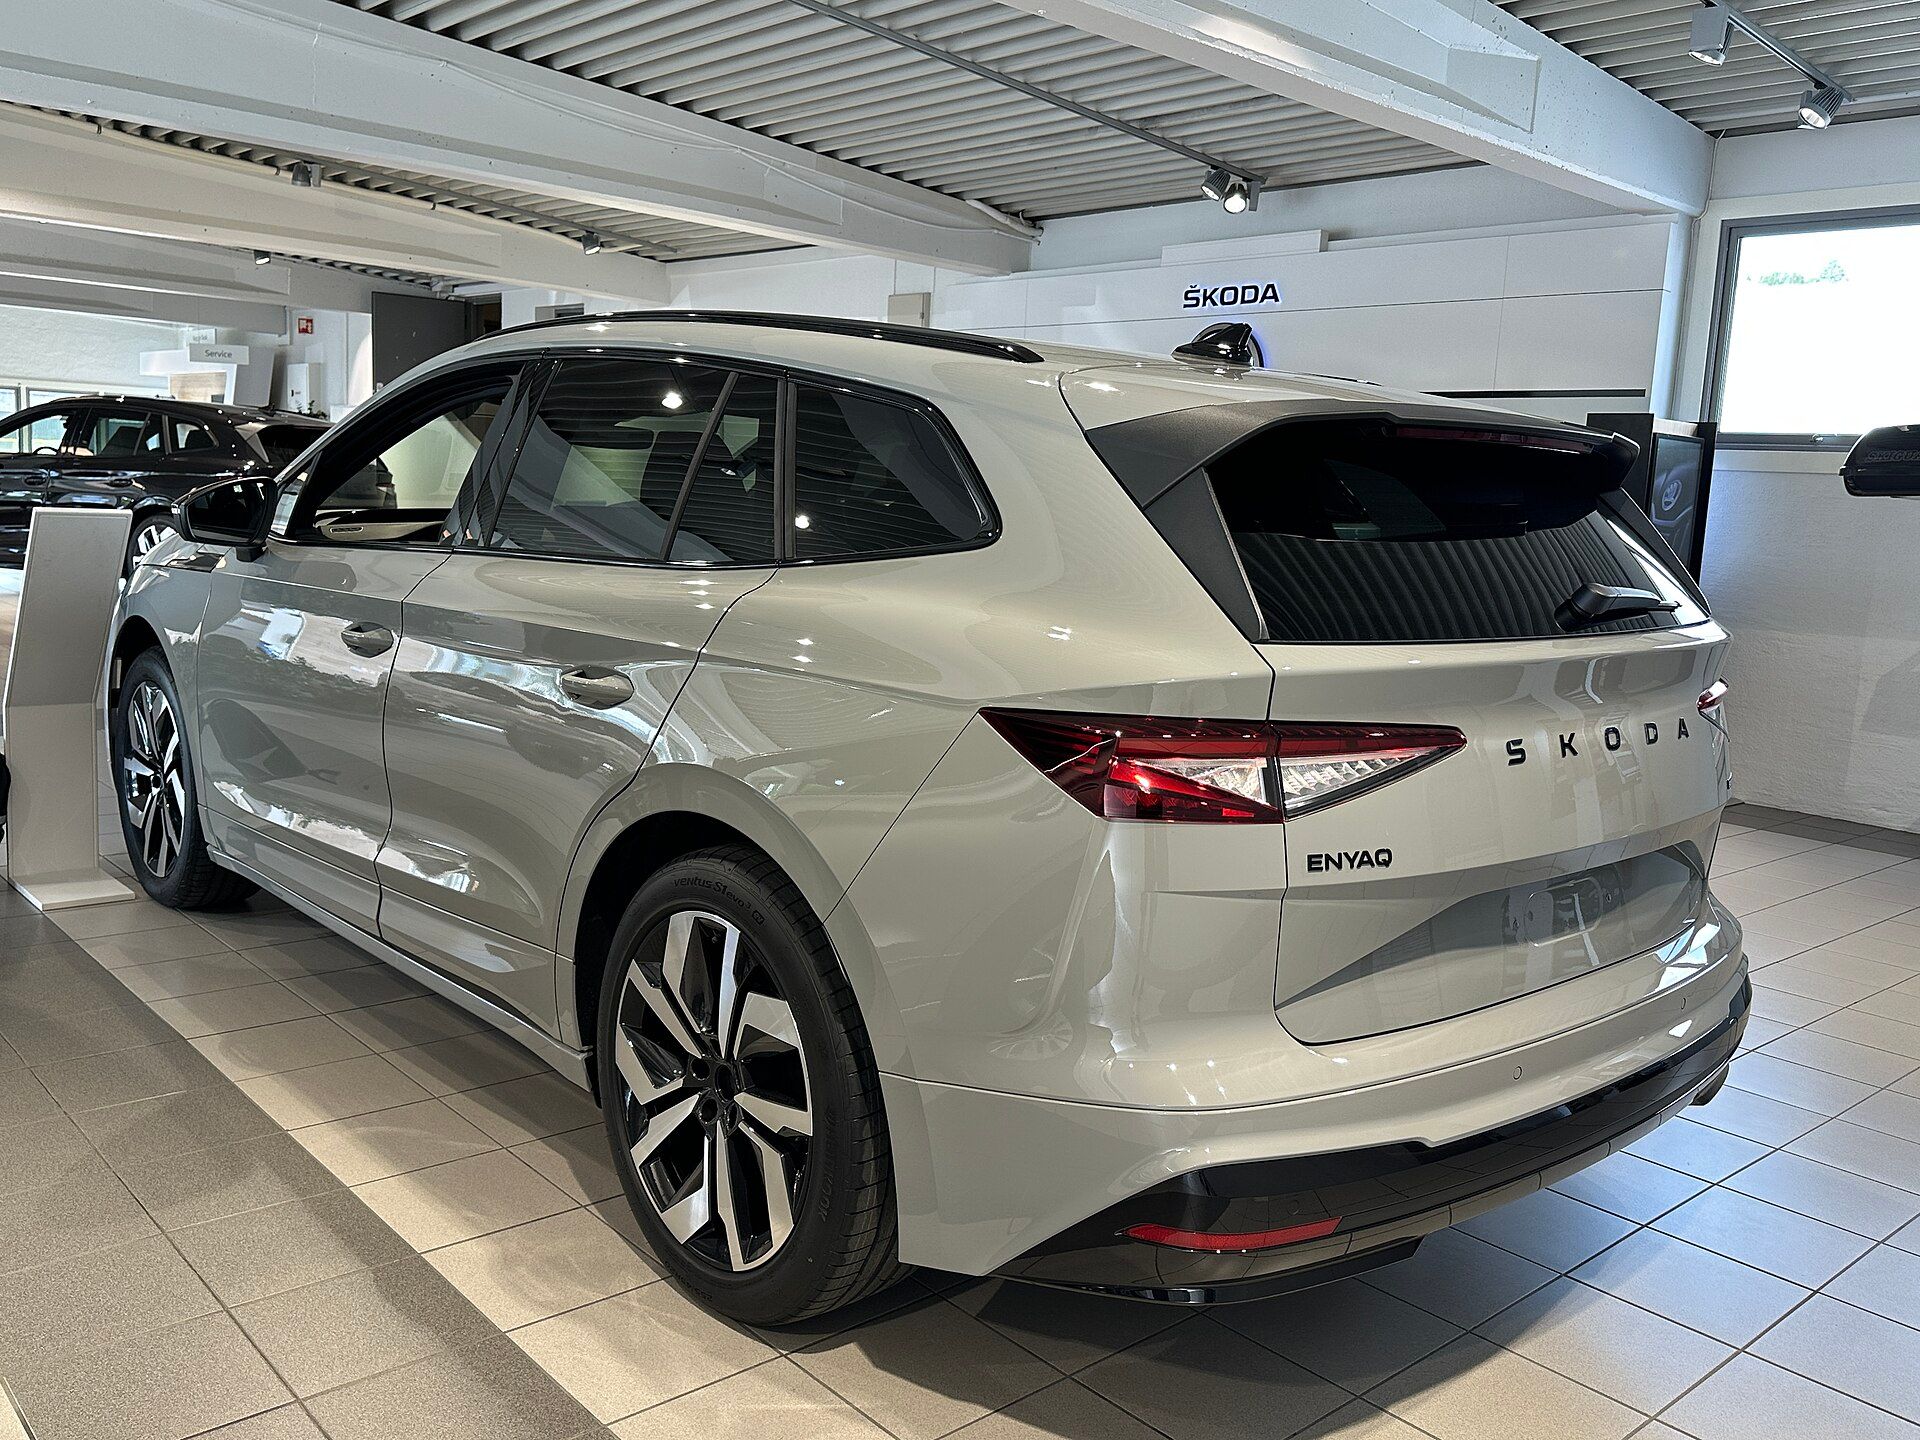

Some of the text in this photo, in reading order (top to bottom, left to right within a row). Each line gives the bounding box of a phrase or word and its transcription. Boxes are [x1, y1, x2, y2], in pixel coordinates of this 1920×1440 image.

[1183, 284, 1280, 308] ŠKODA
[204, 349, 233, 359] Service
[1306, 848, 1393, 873] ENYAQ
